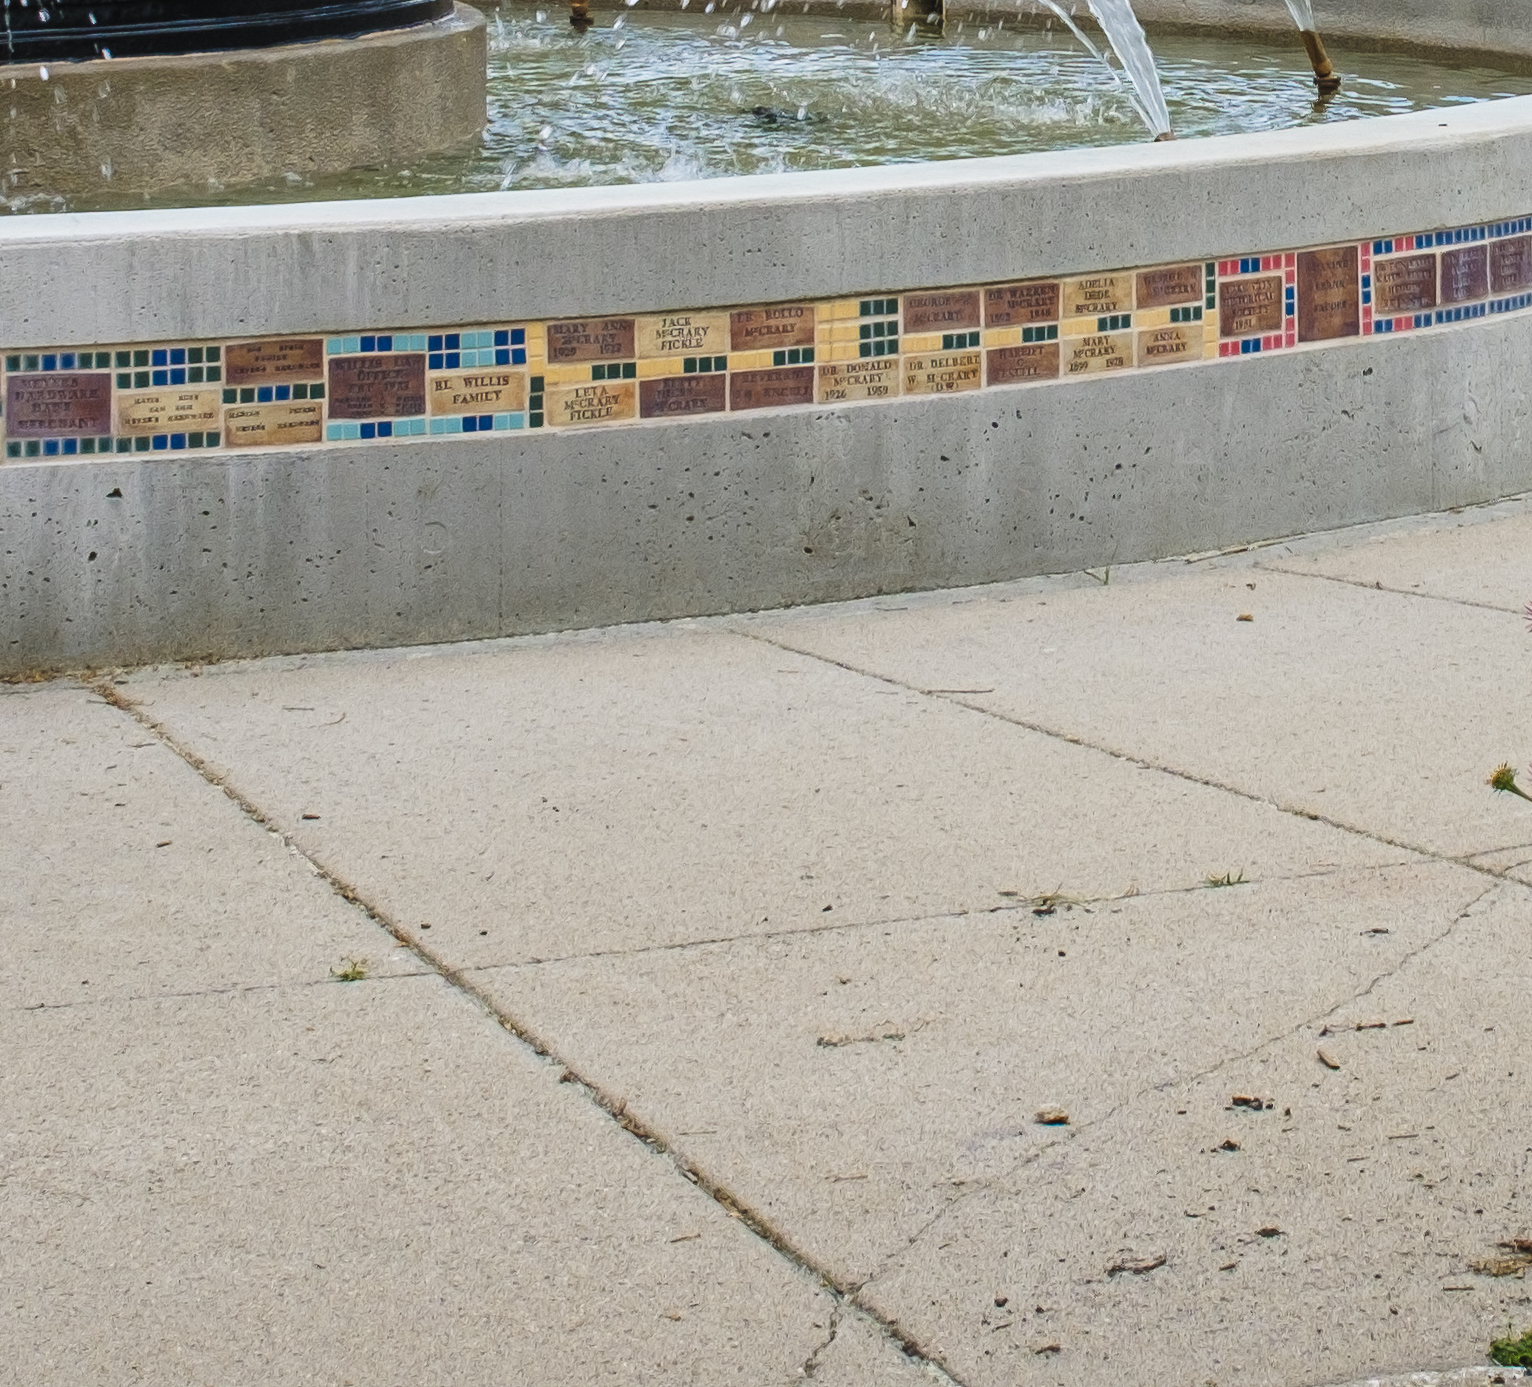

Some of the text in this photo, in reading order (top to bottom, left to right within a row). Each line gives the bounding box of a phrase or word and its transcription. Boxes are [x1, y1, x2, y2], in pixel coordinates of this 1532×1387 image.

[1078, 278, 1115, 291] ADELIA
[765, 307, 804, 321] ROLLO
[662, 317, 692, 328] JACK
[661, 337, 704, 351] FICKLE
[1082, 336, 1111, 347] MARY
[846, 361, 892, 374] DONALD
[930, 355, 980, 369] DELBERT
[463, 375, 510, 388] WILLIS
[907, 374, 917, 385] W
[452, 390, 502, 404] FAMILY
[575, 386, 609, 399] LETA
[569, 407, 613, 421] FICKLE
